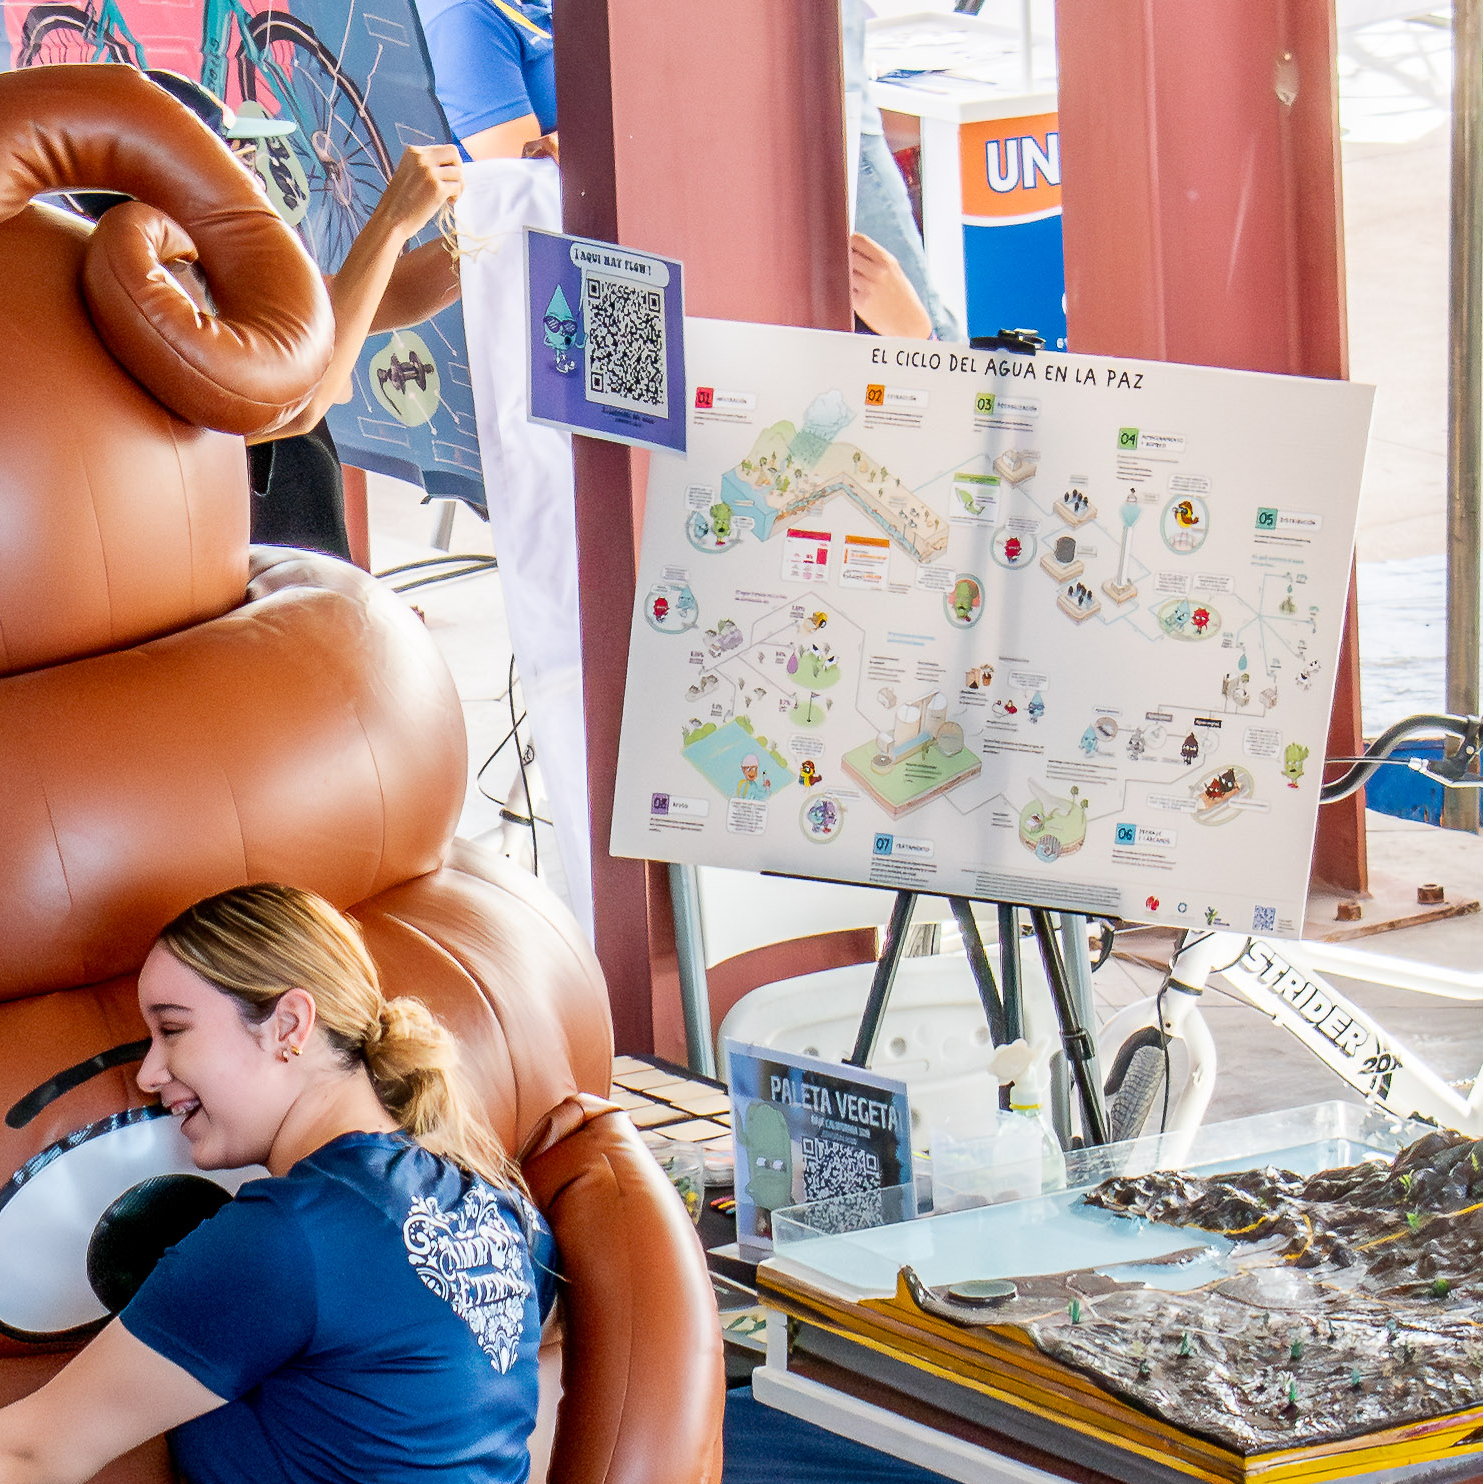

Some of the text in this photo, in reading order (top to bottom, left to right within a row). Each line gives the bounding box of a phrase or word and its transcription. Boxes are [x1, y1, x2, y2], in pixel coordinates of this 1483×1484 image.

[985, 132, 1062, 194] UN
[871, 348, 1144, 389] EL CICLO DEL AGUA EN LA PAZ
[976, 398, 992, 411] 03
[1120, 432, 1136, 446] 04
[1259, 512, 1274, 526] 05
[1118, 828, 1134, 842] 06
[875, 836, 891, 851] 07
[1240, 940, 1371, 1058] STRIDER
[770, 1075, 833, 1115] PALETA
